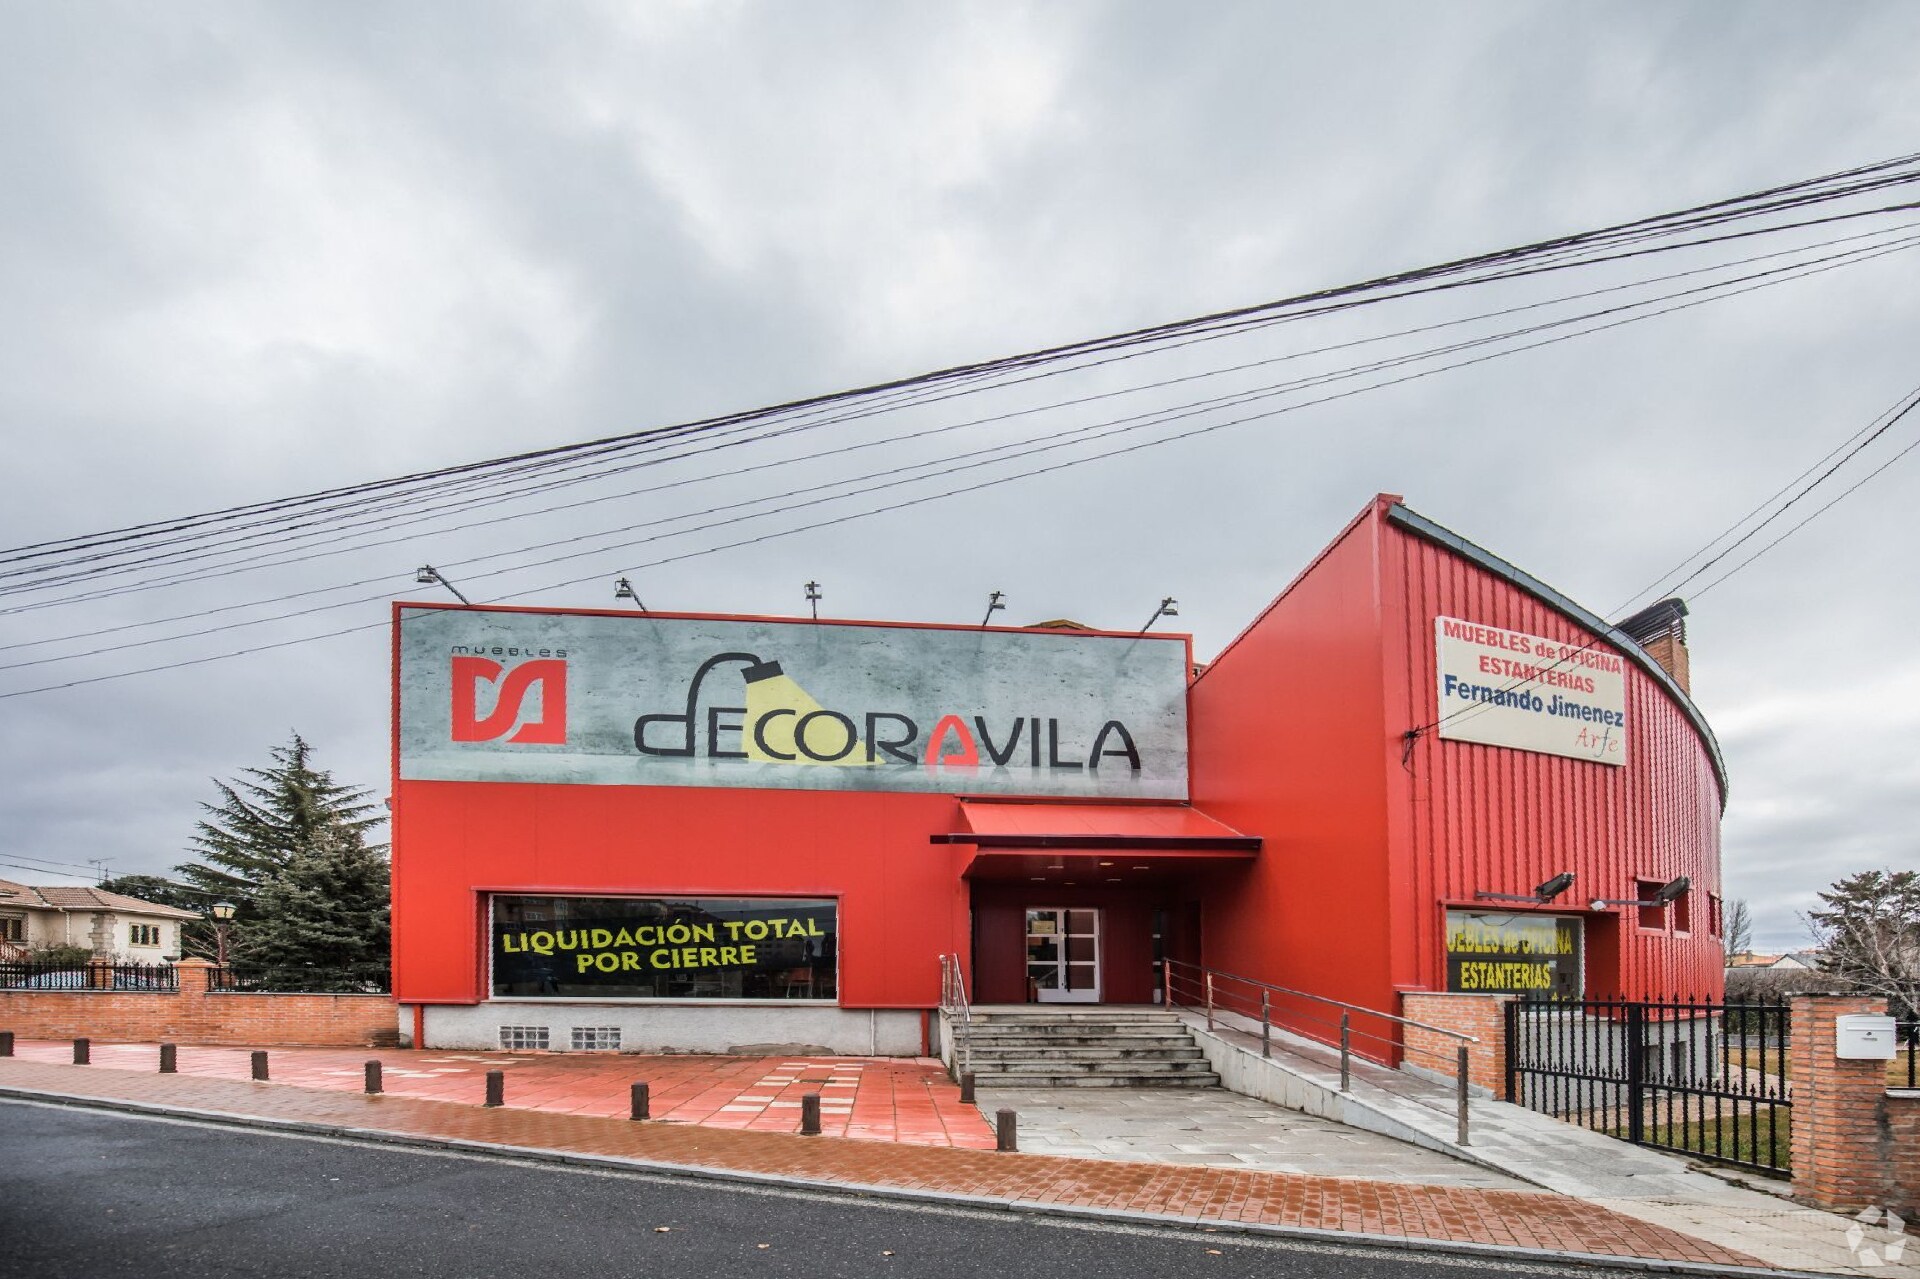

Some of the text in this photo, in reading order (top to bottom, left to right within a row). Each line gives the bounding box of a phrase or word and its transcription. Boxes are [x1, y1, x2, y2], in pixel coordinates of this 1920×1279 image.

[1443, 621, 1622, 674] MUEBLES de OFICINA
[1444, 674, 1624, 727] Fernando Jimenez
[503, 918, 825, 956] LIQUIDACIÓN TOTAL
[576, 945, 758, 974] POR CIERRE
[1461, 961, 1551, 990] ESTANTERIAS
